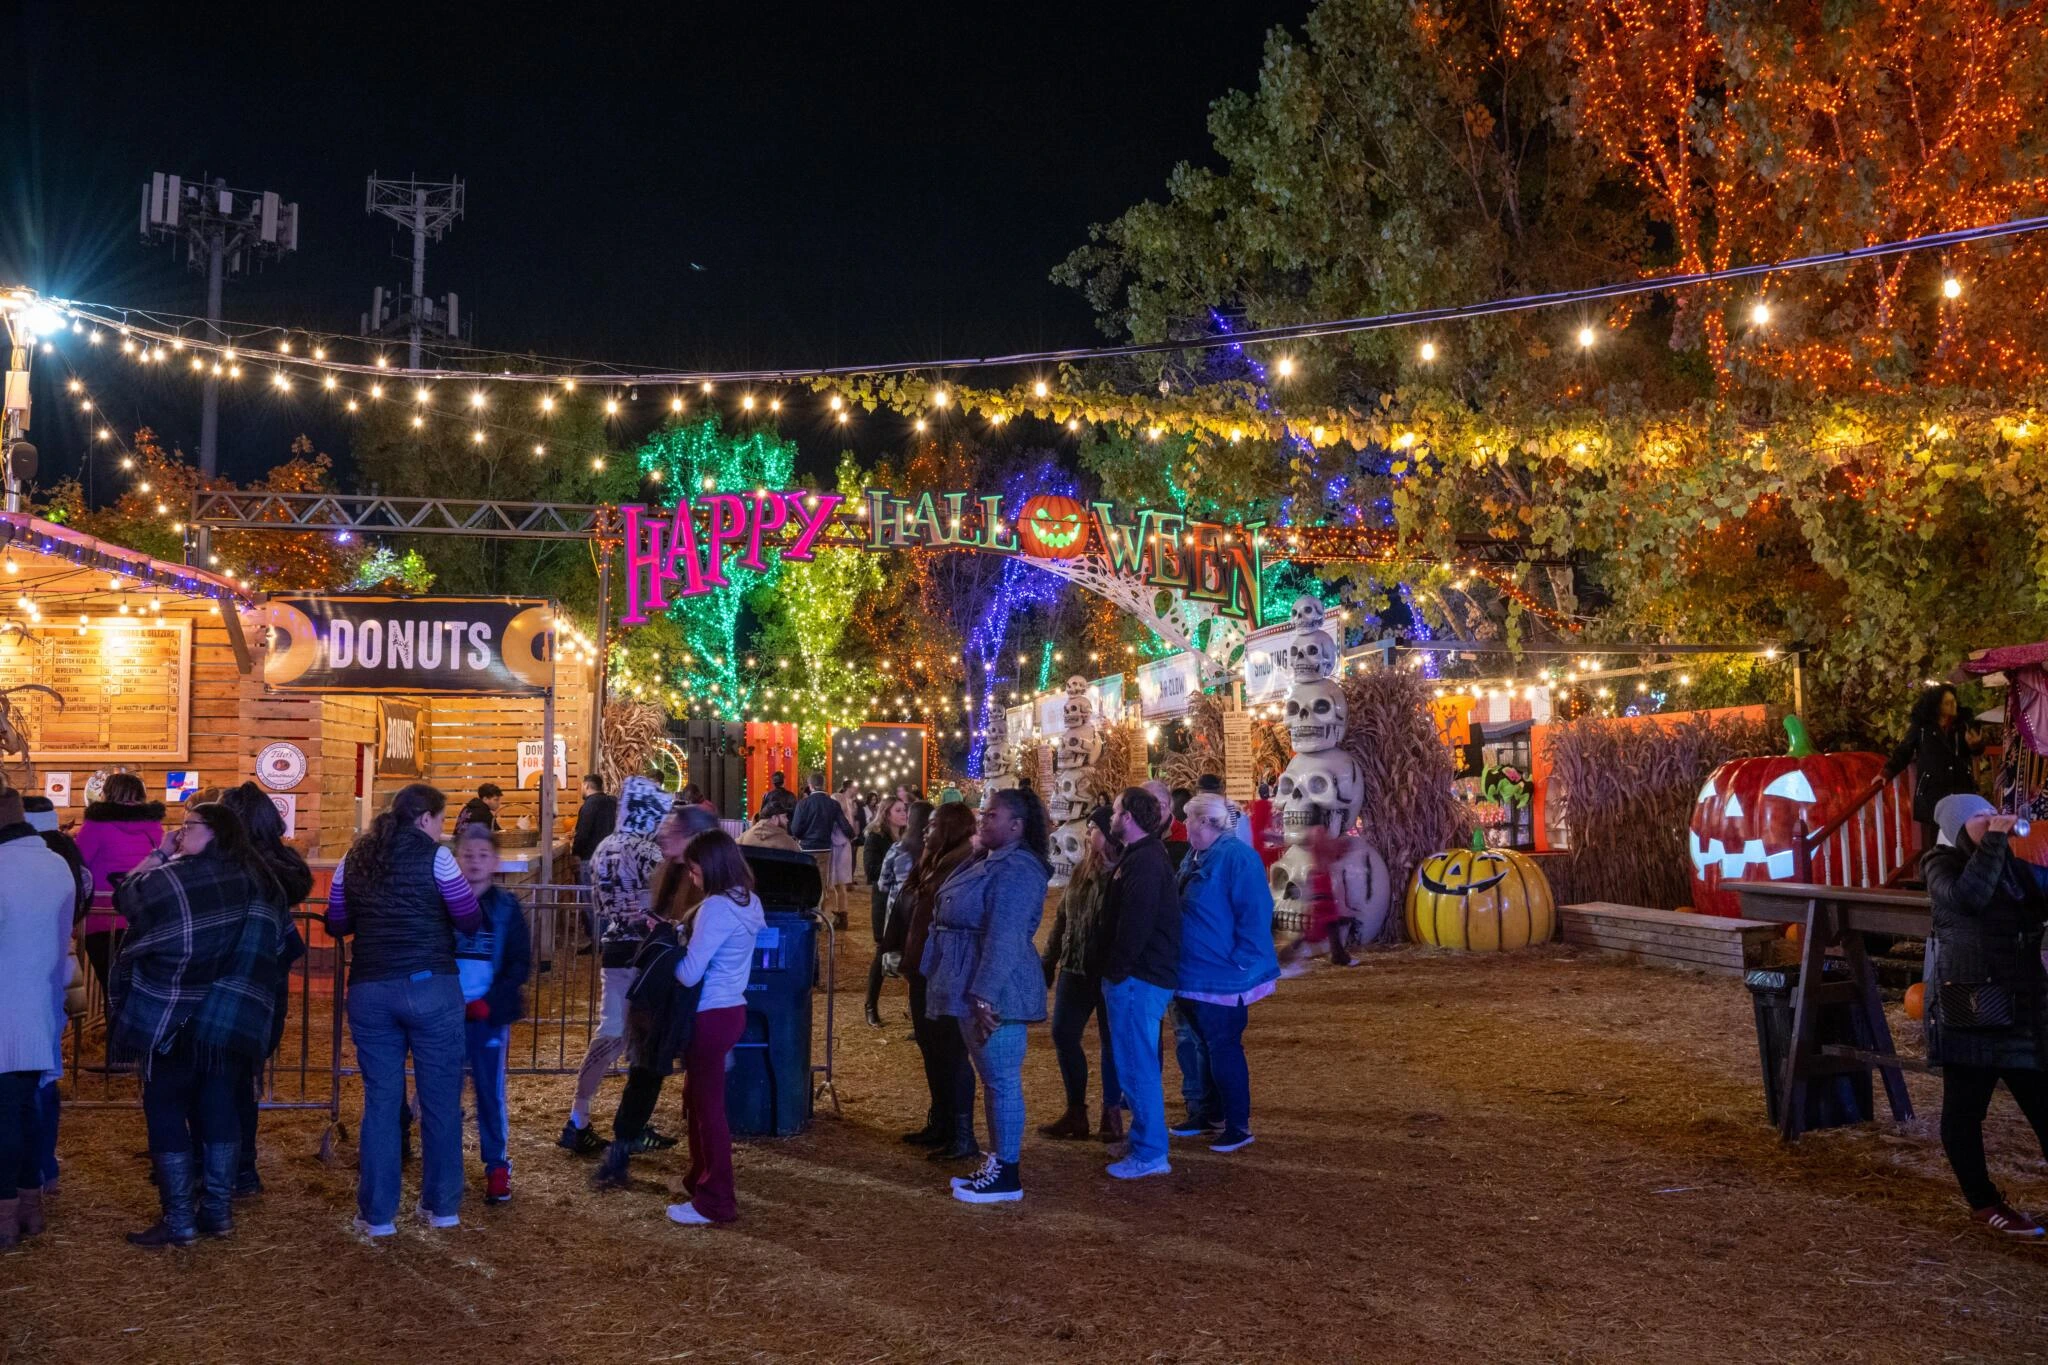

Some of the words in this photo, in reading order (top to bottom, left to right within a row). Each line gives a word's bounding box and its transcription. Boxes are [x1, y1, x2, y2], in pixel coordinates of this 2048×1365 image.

[619, 489, 844, 626] HAPPY
[329, 619, 492, 670] DONUTS
[1254, 649, 1288, 678] SHOOTING
[386, 716, 415, 759] DONUTS
[525, 744, 559, 756] DONS
[270, 750, 293, 758] Tito's
[522, 757, 539, 768] FOR
